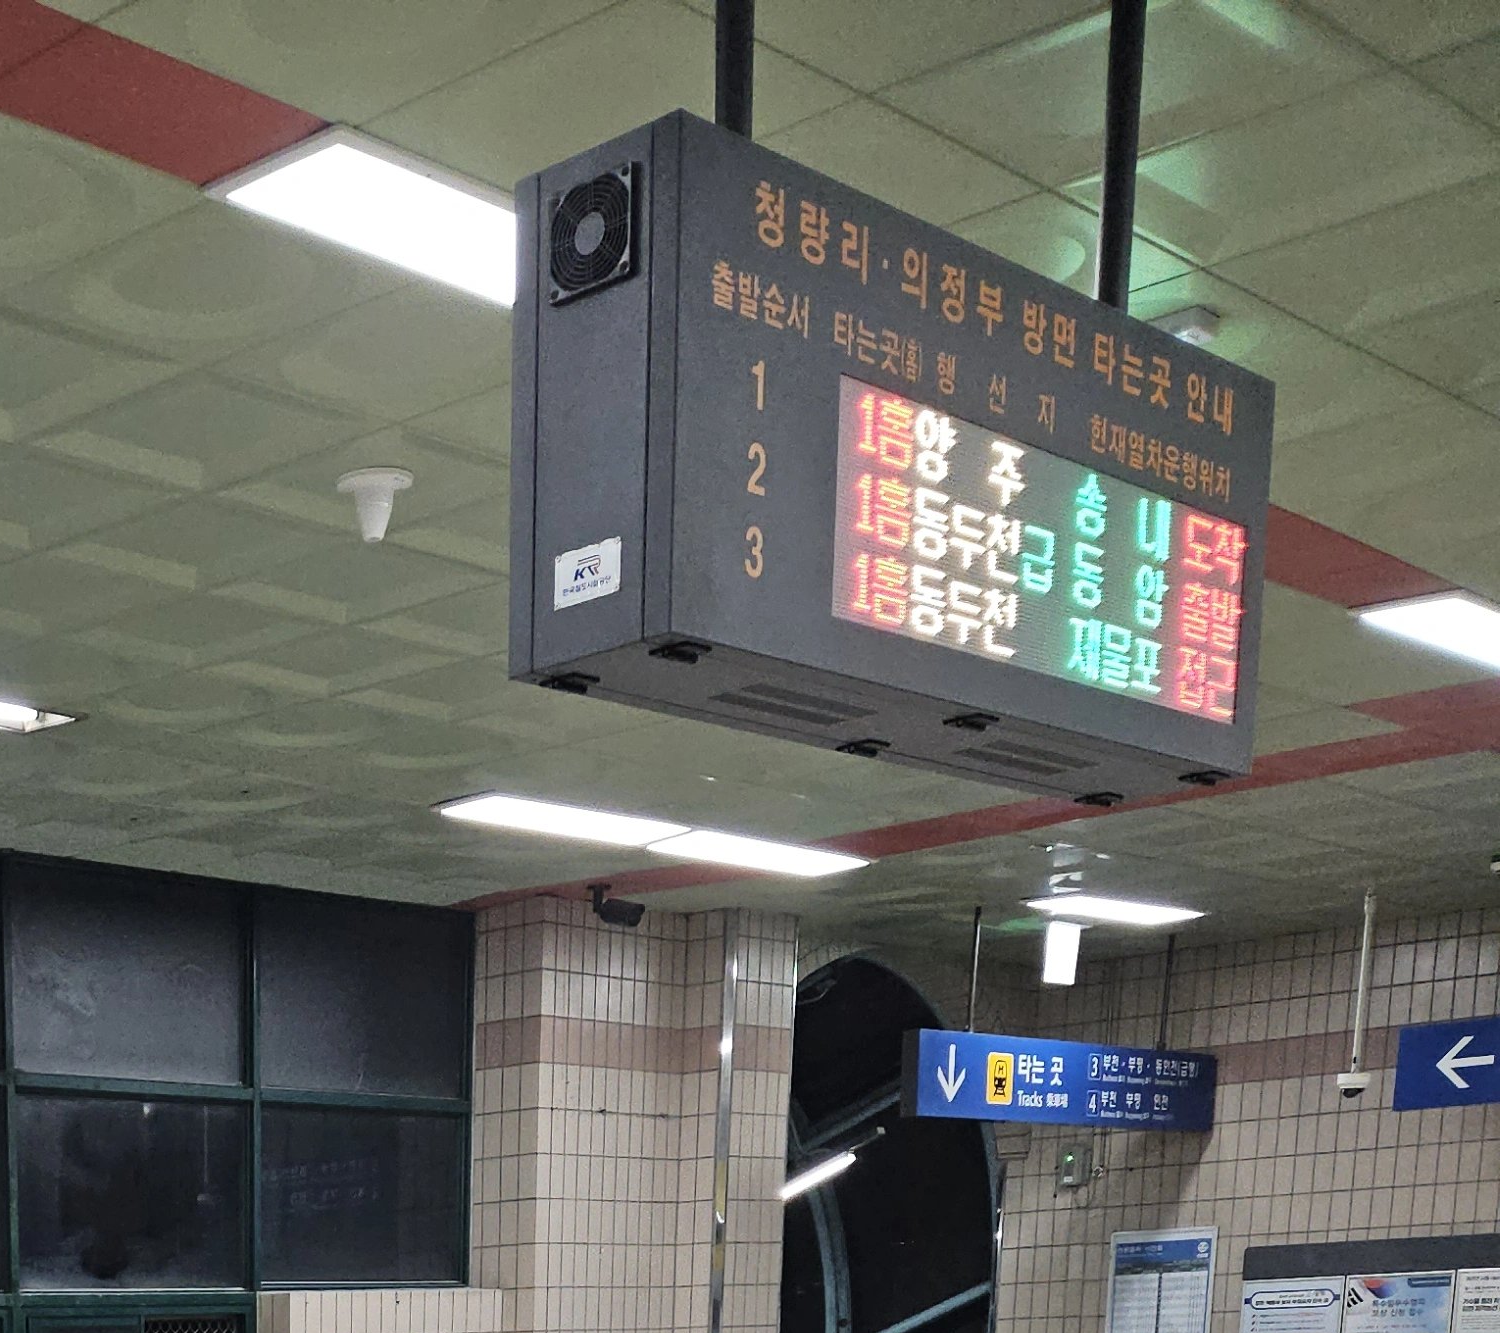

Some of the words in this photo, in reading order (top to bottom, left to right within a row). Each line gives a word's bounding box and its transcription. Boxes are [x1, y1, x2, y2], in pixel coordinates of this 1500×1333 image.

[711, 259, 810, 339] 출발순서
[1090, 413, 1231, 503] 현재열차운행위치
[750, 360, 766, 412] 1
[1022, 299, 1077, 369] 방면
[1093, 332, 1173, 410] 타는곳
[1186, 372, 1235, 436] 안내
[746, 442, 767, 497] 2
[743, 525, 764, 579] 3
[1182, 513, 1249, 587] 도착
[909, 563, 1022, 659] 동두천
[1175, 646, 1238, 720] 접근
[1180, 580, 1246, 652] 출발
[1017, 1053, 1045, 1085] 타는
[1050, 1056, 1065, 1087] 곳
[1091, 1056, 1100, 1078] 3
[1017, 1090, 1044, 1108] Tracks
[1088, 1092, 1097, 1114] 4
